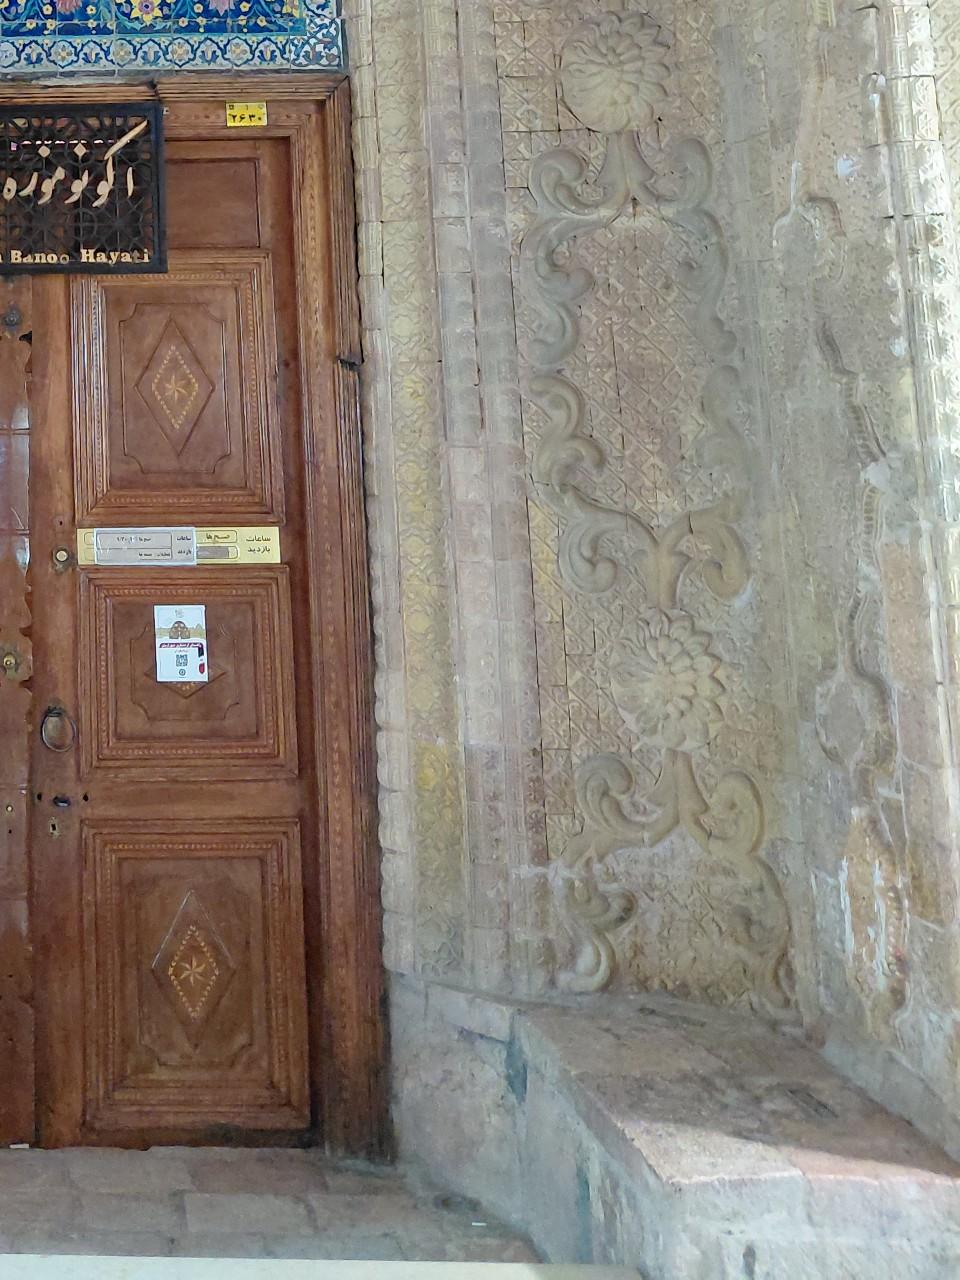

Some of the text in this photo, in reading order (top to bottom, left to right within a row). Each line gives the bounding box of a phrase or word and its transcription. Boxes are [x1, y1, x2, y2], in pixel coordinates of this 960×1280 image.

[10, 249, 70, 265] Banoo
[80, 248, 151, 266] Hayati
[246, 534, 271, 542] ساعات
[247, 545, 271, 554] بازدید
